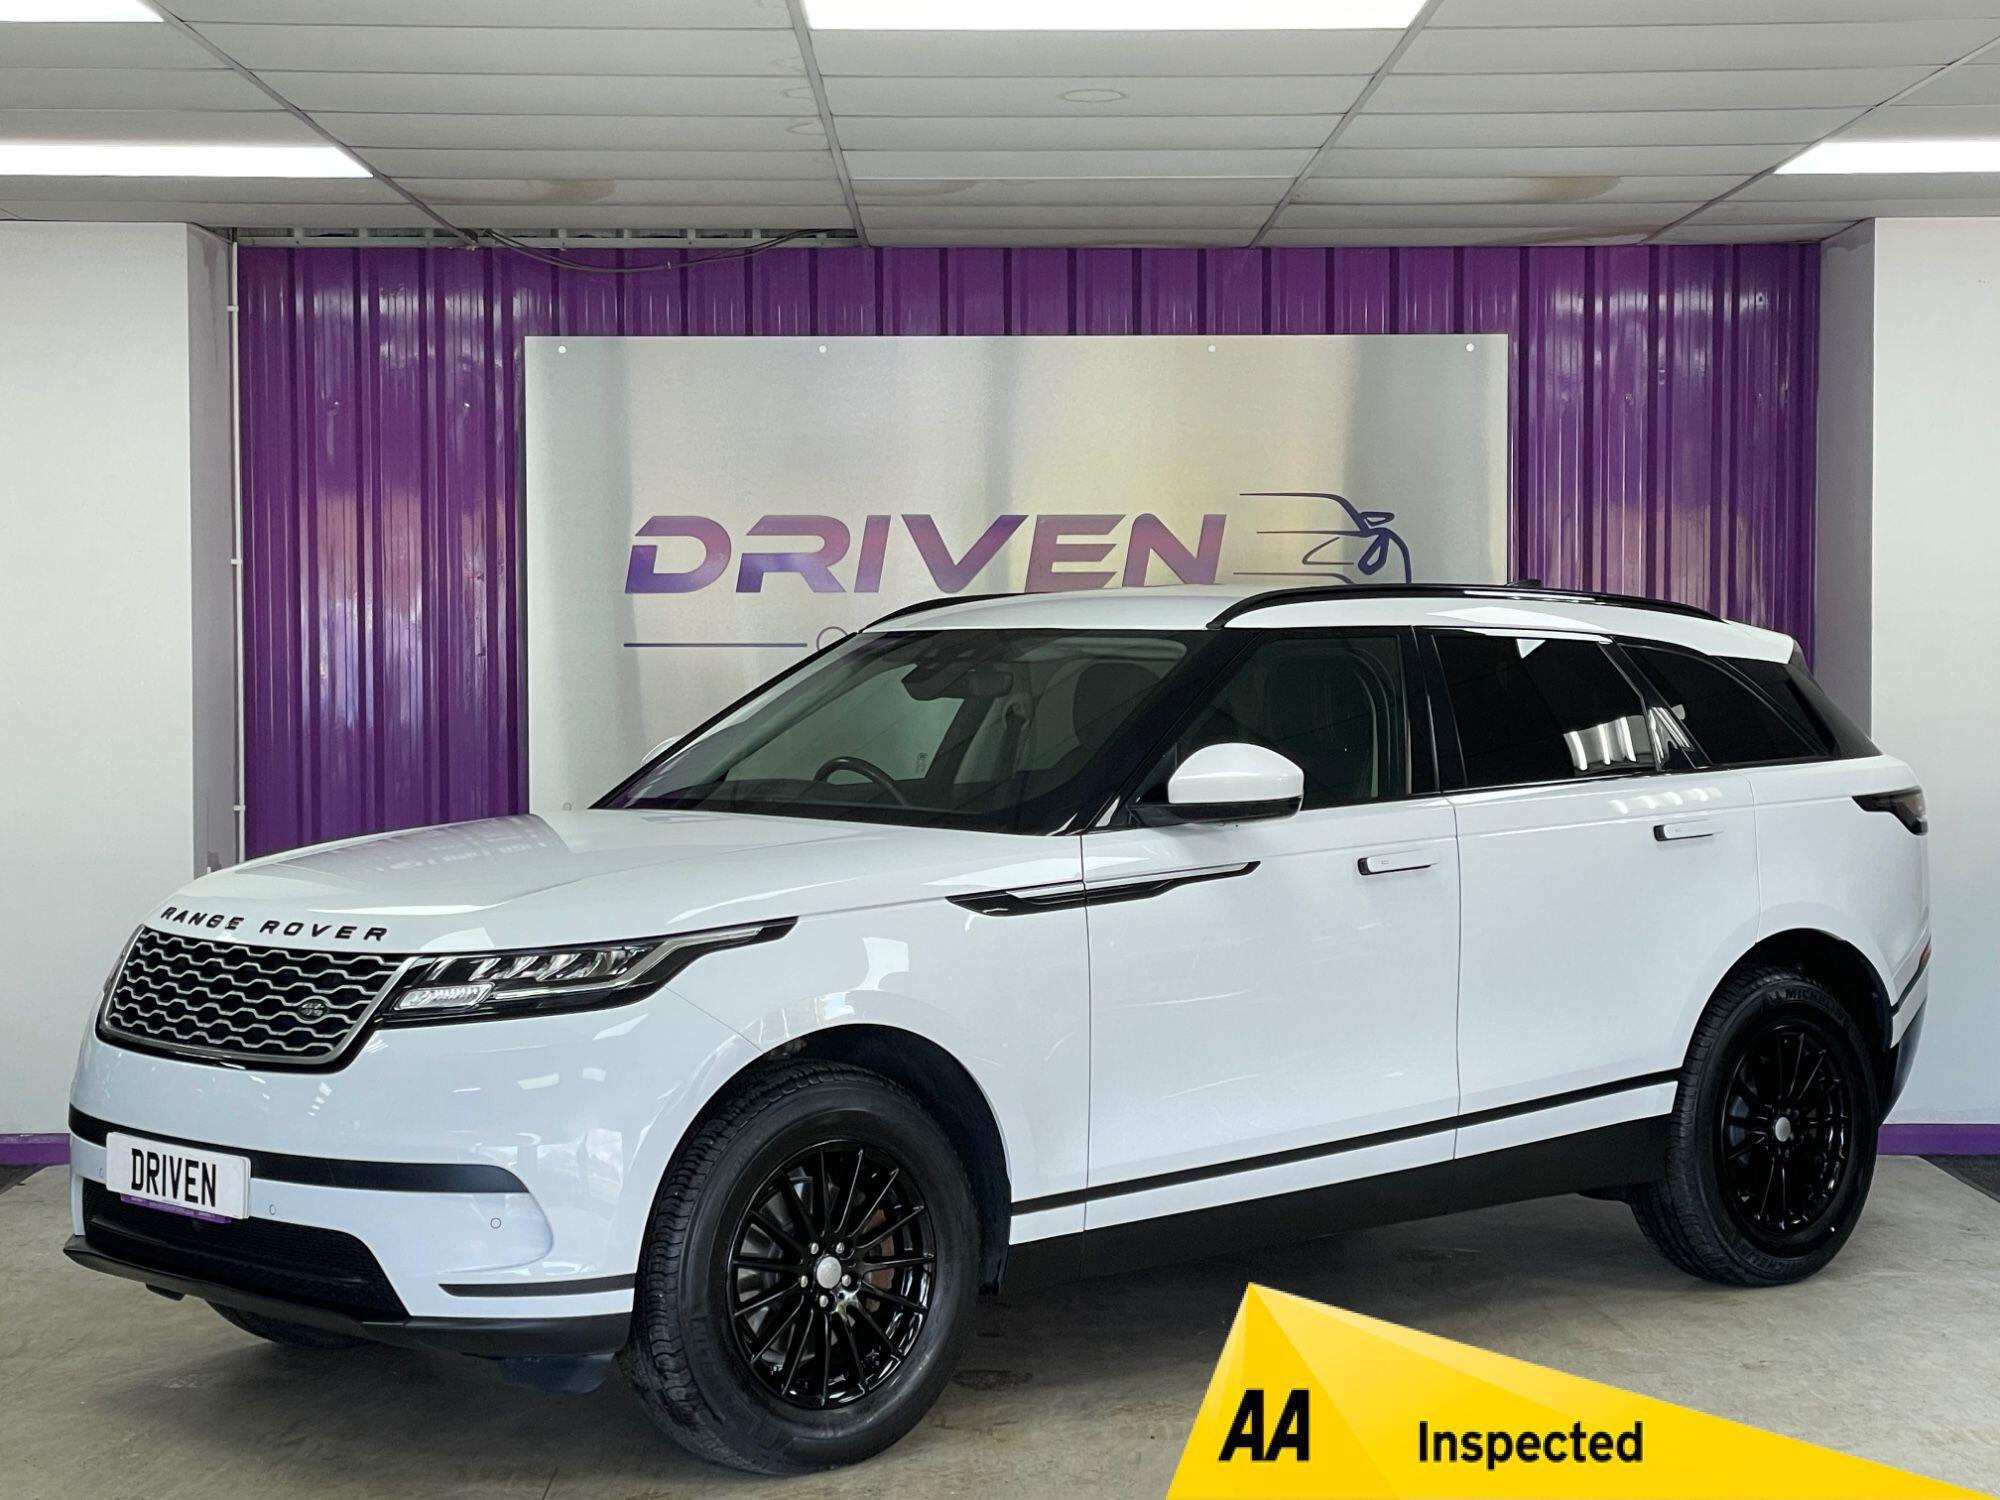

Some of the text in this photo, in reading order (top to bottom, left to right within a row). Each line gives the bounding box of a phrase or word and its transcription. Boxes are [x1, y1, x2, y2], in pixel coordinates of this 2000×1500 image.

[624, 513, 1227, 595] DRIVEN
[160, 906, 388, 942] RANGE ROVER
[130, 1147, 217, 1208] DRIVEN
